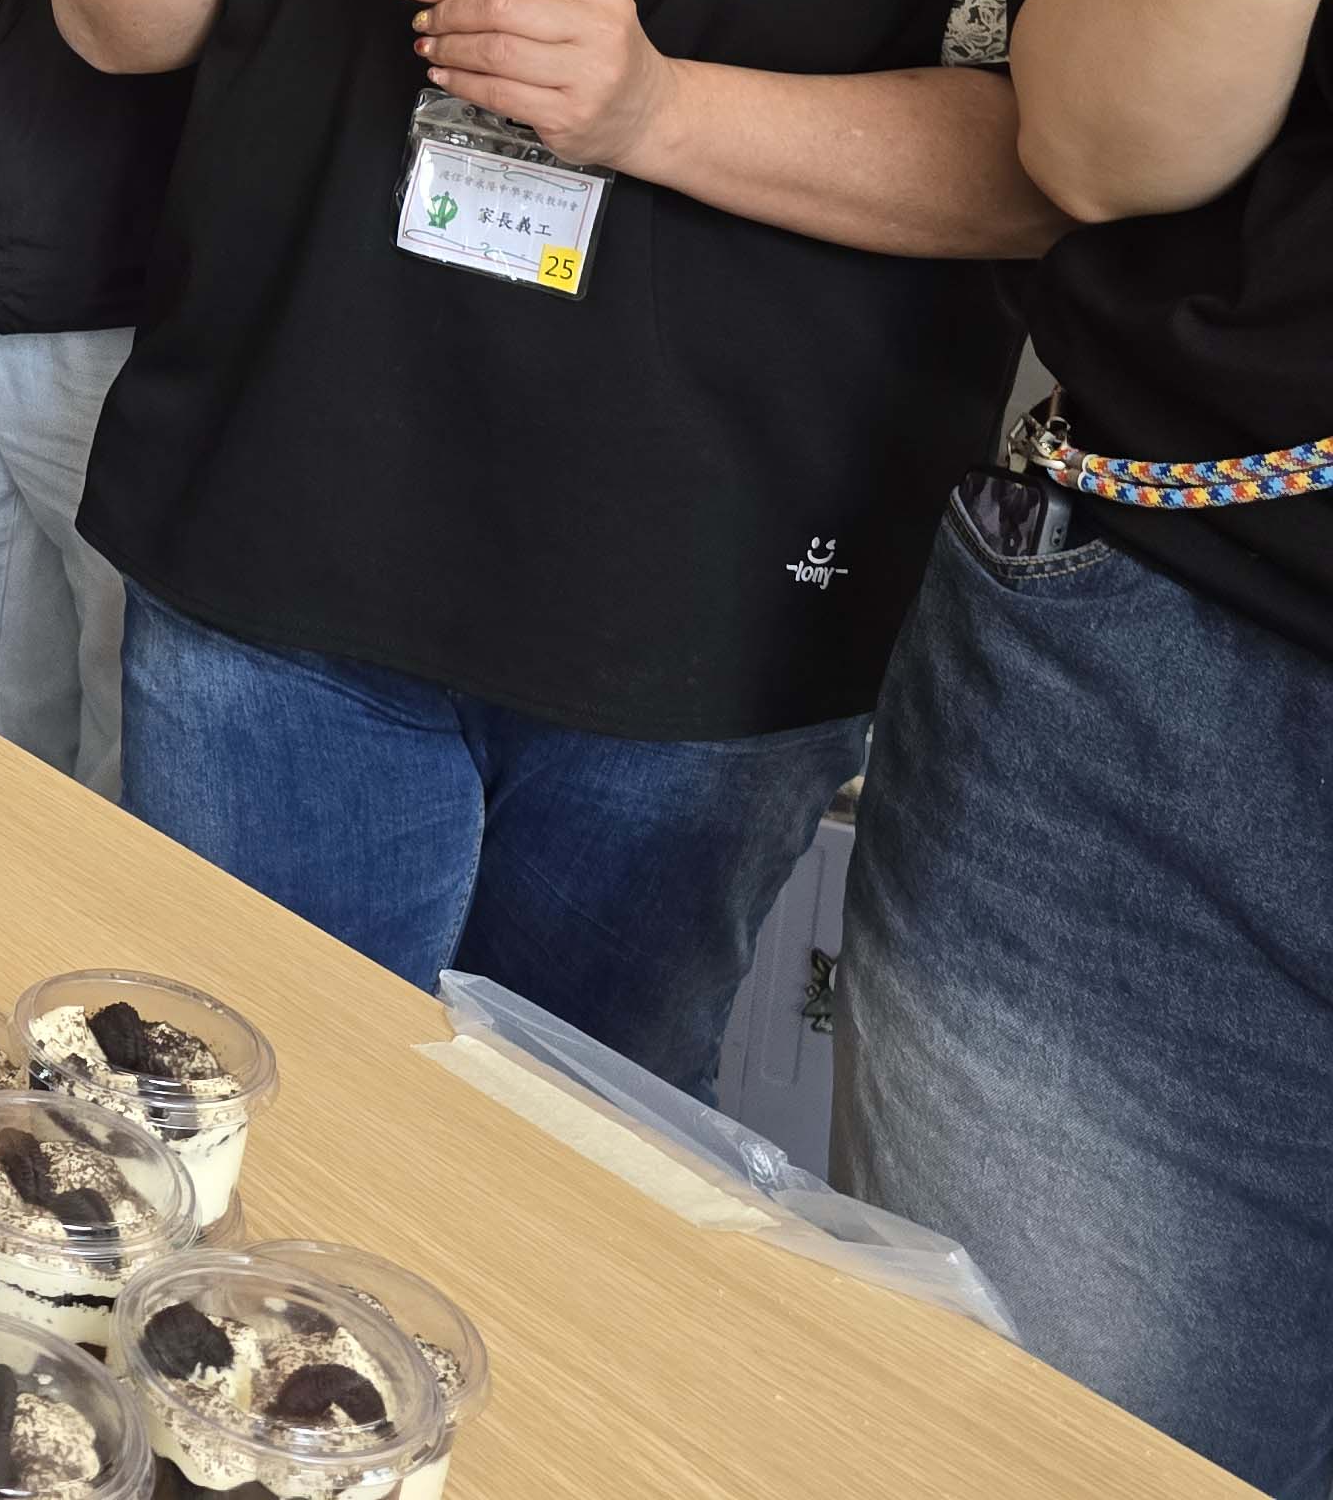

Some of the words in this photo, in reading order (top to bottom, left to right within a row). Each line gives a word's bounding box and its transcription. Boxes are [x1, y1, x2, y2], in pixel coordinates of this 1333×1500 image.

[478, 206, 553, 238] 家長義工
[545, 255, 575, 281] 25
